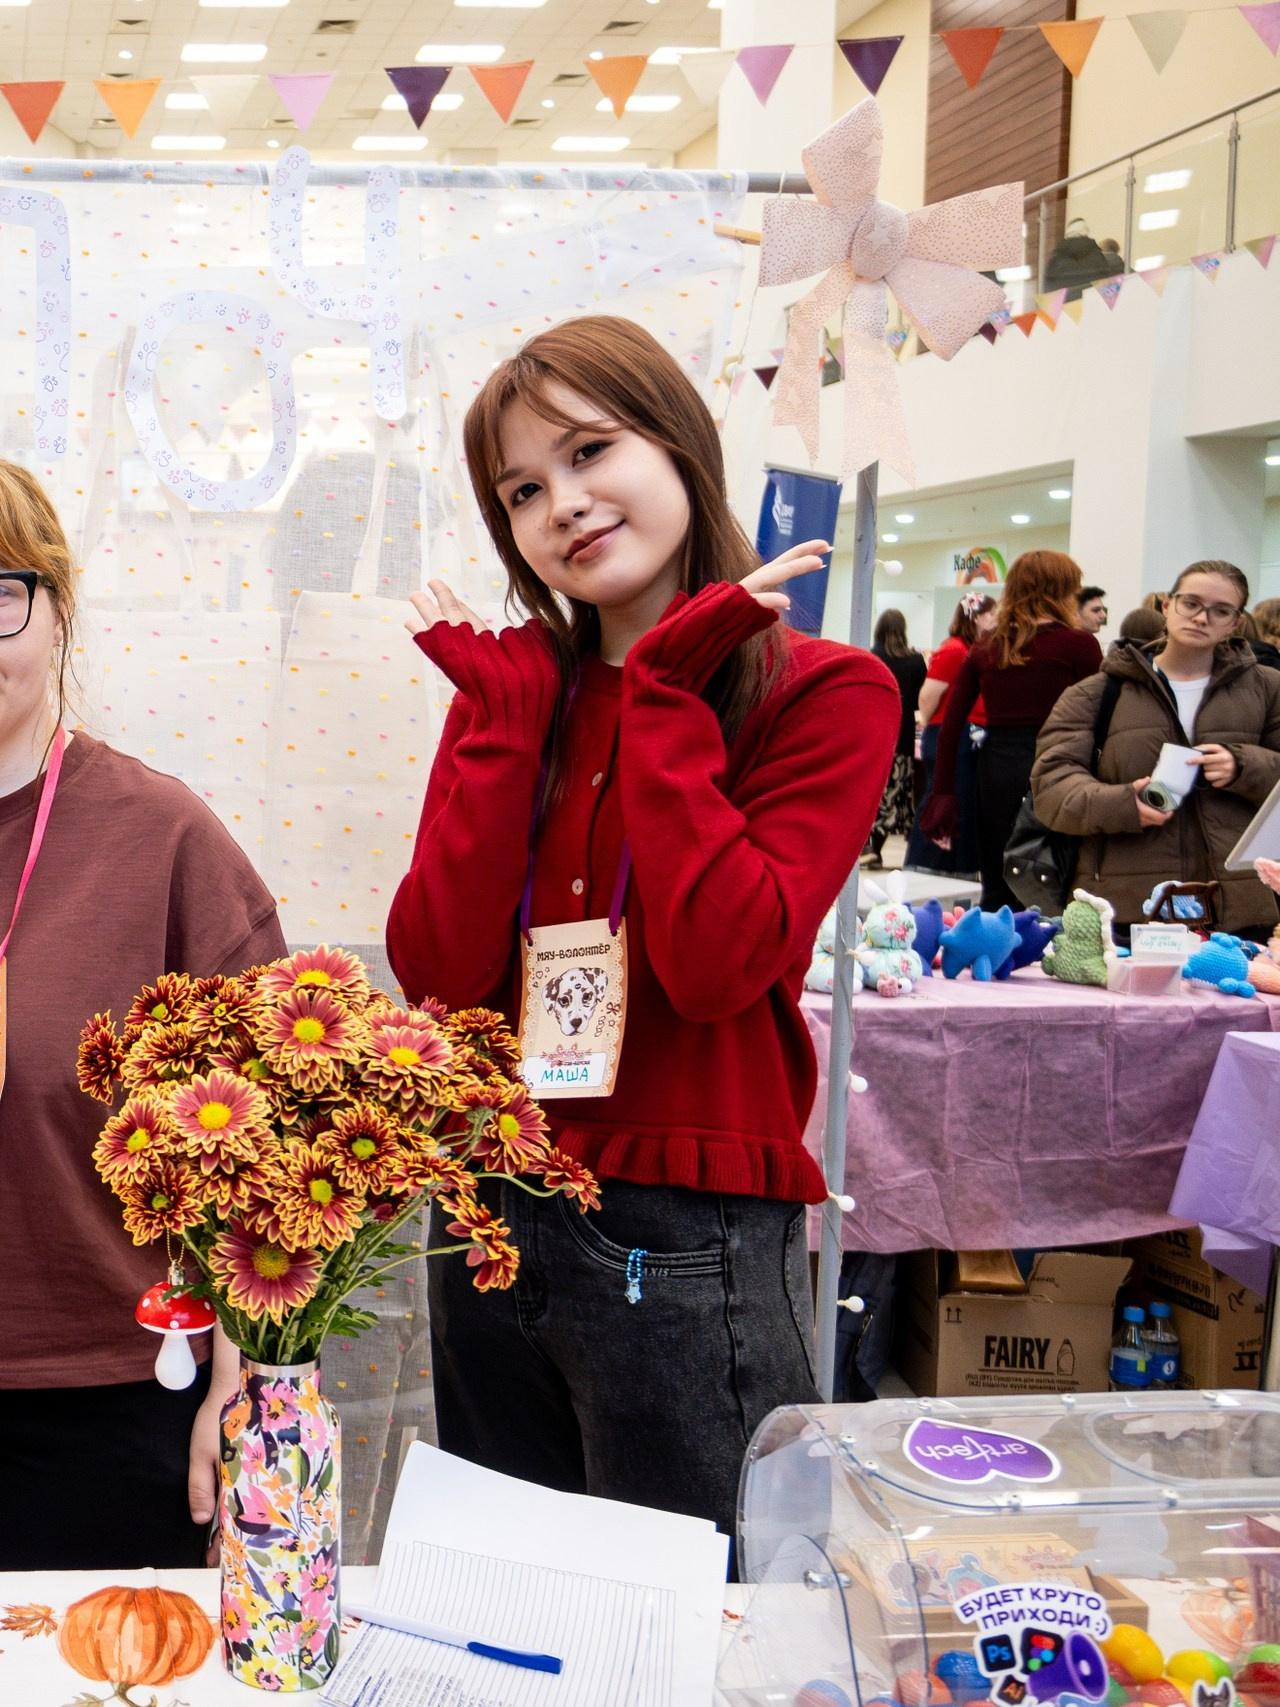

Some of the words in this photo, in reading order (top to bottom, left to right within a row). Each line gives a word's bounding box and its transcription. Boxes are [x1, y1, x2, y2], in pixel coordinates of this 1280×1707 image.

[953, 553, 981, 573] Кафе
[536, 943, 611, 962] МЯУ-ВОЛОНТЁР
[540, 1067, 589, 1083] МАША
[983, 1335, 1051, 1370] FAIRY
[959, 1587, 1024, 1618] БУДЕТ
[1029, 1587, 1102, 1611] КРУТО
[981, 1608, 1091, 1630] ПРИХОДИ
[986, 1644, 1012, 1664] Ps
